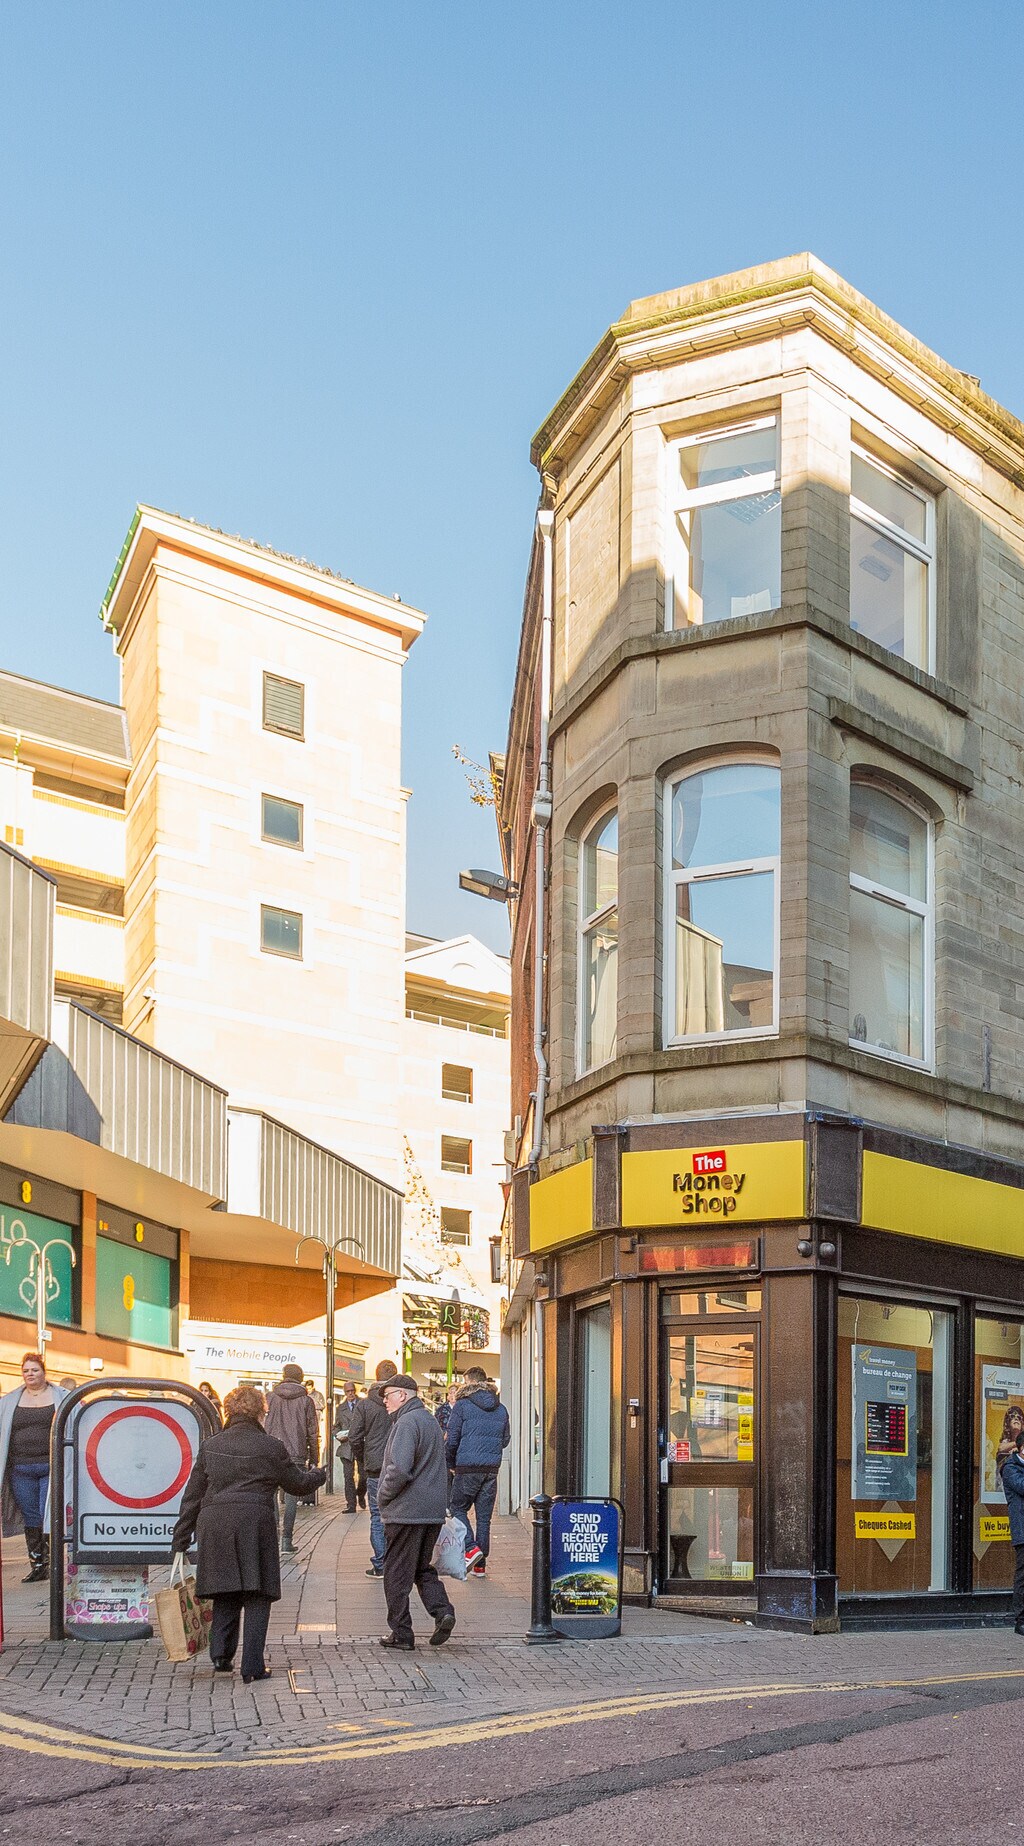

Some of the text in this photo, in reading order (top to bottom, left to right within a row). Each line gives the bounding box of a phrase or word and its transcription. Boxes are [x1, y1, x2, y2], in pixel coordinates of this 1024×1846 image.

[695, 1155, 723, 1171] The
[673, 1172, 746, 1194] Money
[682, 1193, 737, 1217] Shop
[205, 1346, 297, 1363] The Mobile People
[881, 1359, 896, 1367] money
[862, 1366, 913, 1380] bureau de change
[569, 1513, 602, 1524] SEND
[94, 1523, 175, 1536] No vehicle
[572, 1523, 599, 1534] AND
[858, 1519, 912, 1531] Cheques Cashed
[984, 1520, 1010, 1532] We buy
[561, 1533, 609, 1544] RECEIVE
[563, 1543, 607, 1553] MONEY
[570, 1552, 600, 1563] HERE
